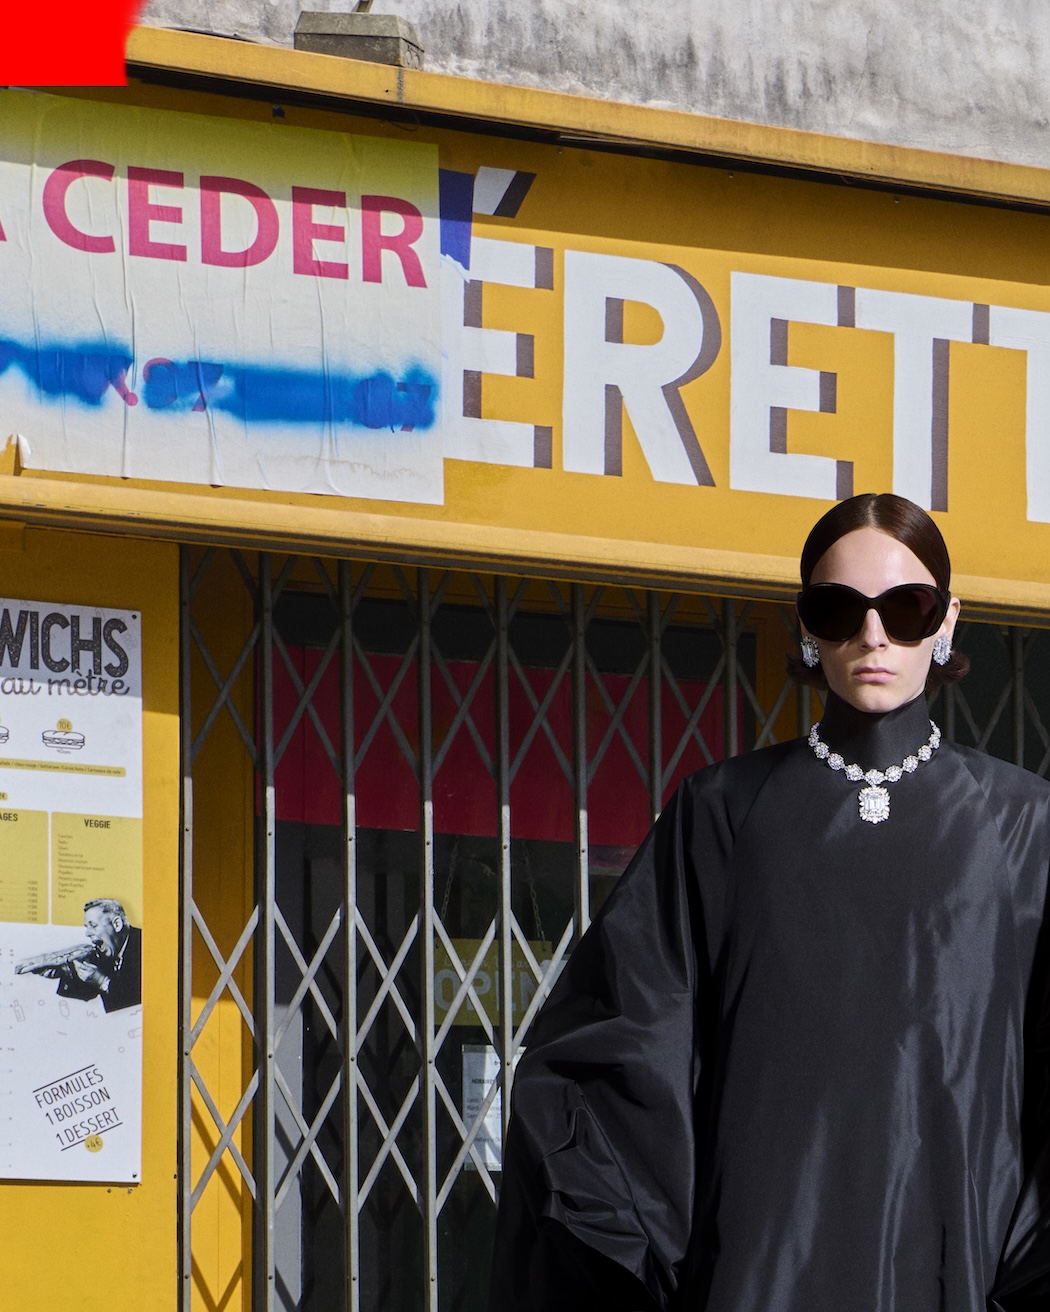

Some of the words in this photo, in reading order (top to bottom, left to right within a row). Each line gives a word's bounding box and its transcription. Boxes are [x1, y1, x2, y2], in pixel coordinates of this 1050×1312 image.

[42, 159, 428, 288] CEDER
[1, 678, 41, 695] au
[48, 668, 130, 696] mètre
[83, 818, 111, 829] VEGGIE
[34, 1068, 104, 1109] FORMULES
[45, 1112, 54, 1125] 1
[53, 1086, 111, 1122] BOISSON
[56, 1133, 65, 1146] 1
[64, 1107, 120, 1143] DESSERT
